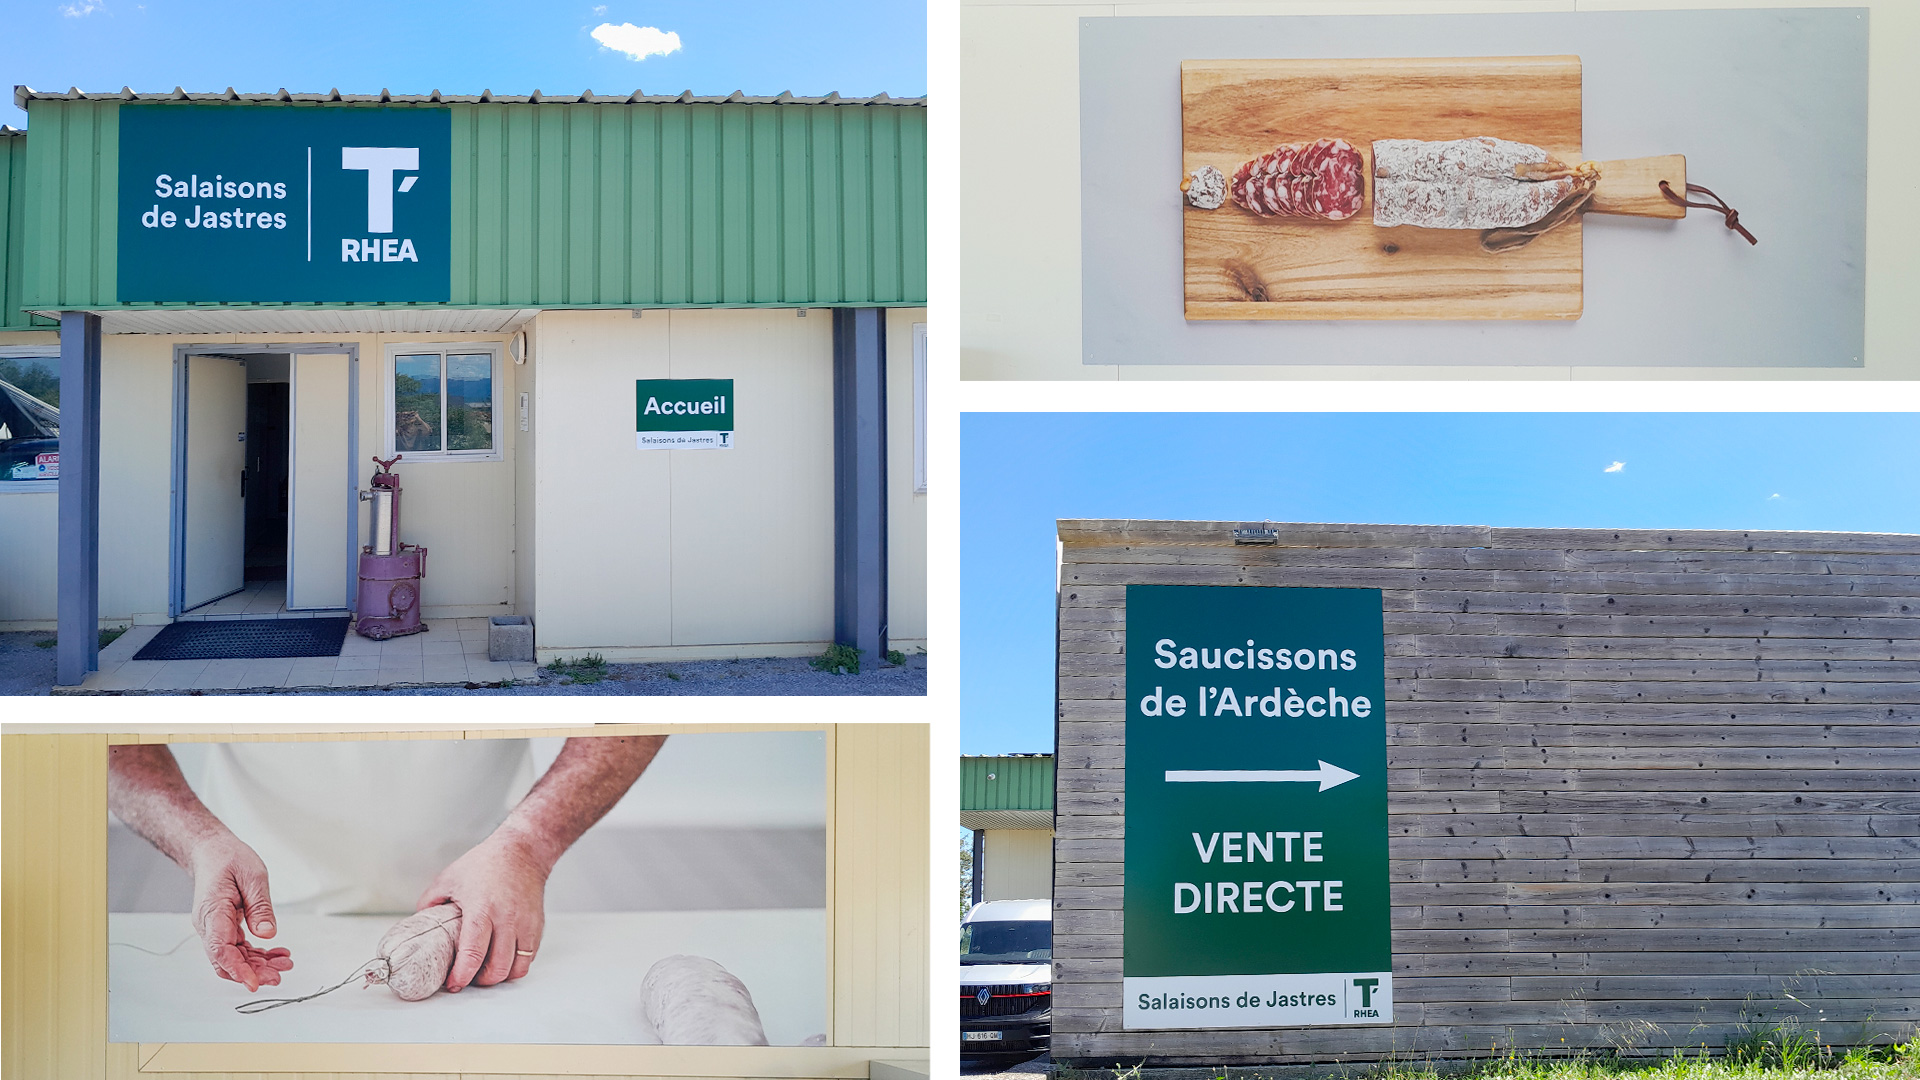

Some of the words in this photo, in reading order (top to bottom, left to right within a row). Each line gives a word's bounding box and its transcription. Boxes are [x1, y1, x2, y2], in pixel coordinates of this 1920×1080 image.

[155, 174, 287, 200] Salaisons
[141, 204, 177, 229] de
[185, 205, 287, 230] Jastres
[341, 238, 419, 263] RHEA
[643, 395, 726, 416] Accueil
[641, 436, 676, 444] Salaisons
[687, 436, 714, 444] Jastres
[1154, 638, 1357, 671] Saucissons
[1140, 686, 1187, 717] de
[1199, 686, 1372, 718] l'Ardèche
[1191, 831, 1324, 863] VENTE
[1174, 880, 1344, 914] DIRECTE
[1137, 992, 1230, 1010] Salaisons
[1236, 991, 1261, 1009] de
[1266, 990, 1337, 1008] Jastres
[1353, 1009, 1379, 1018] RHEA
